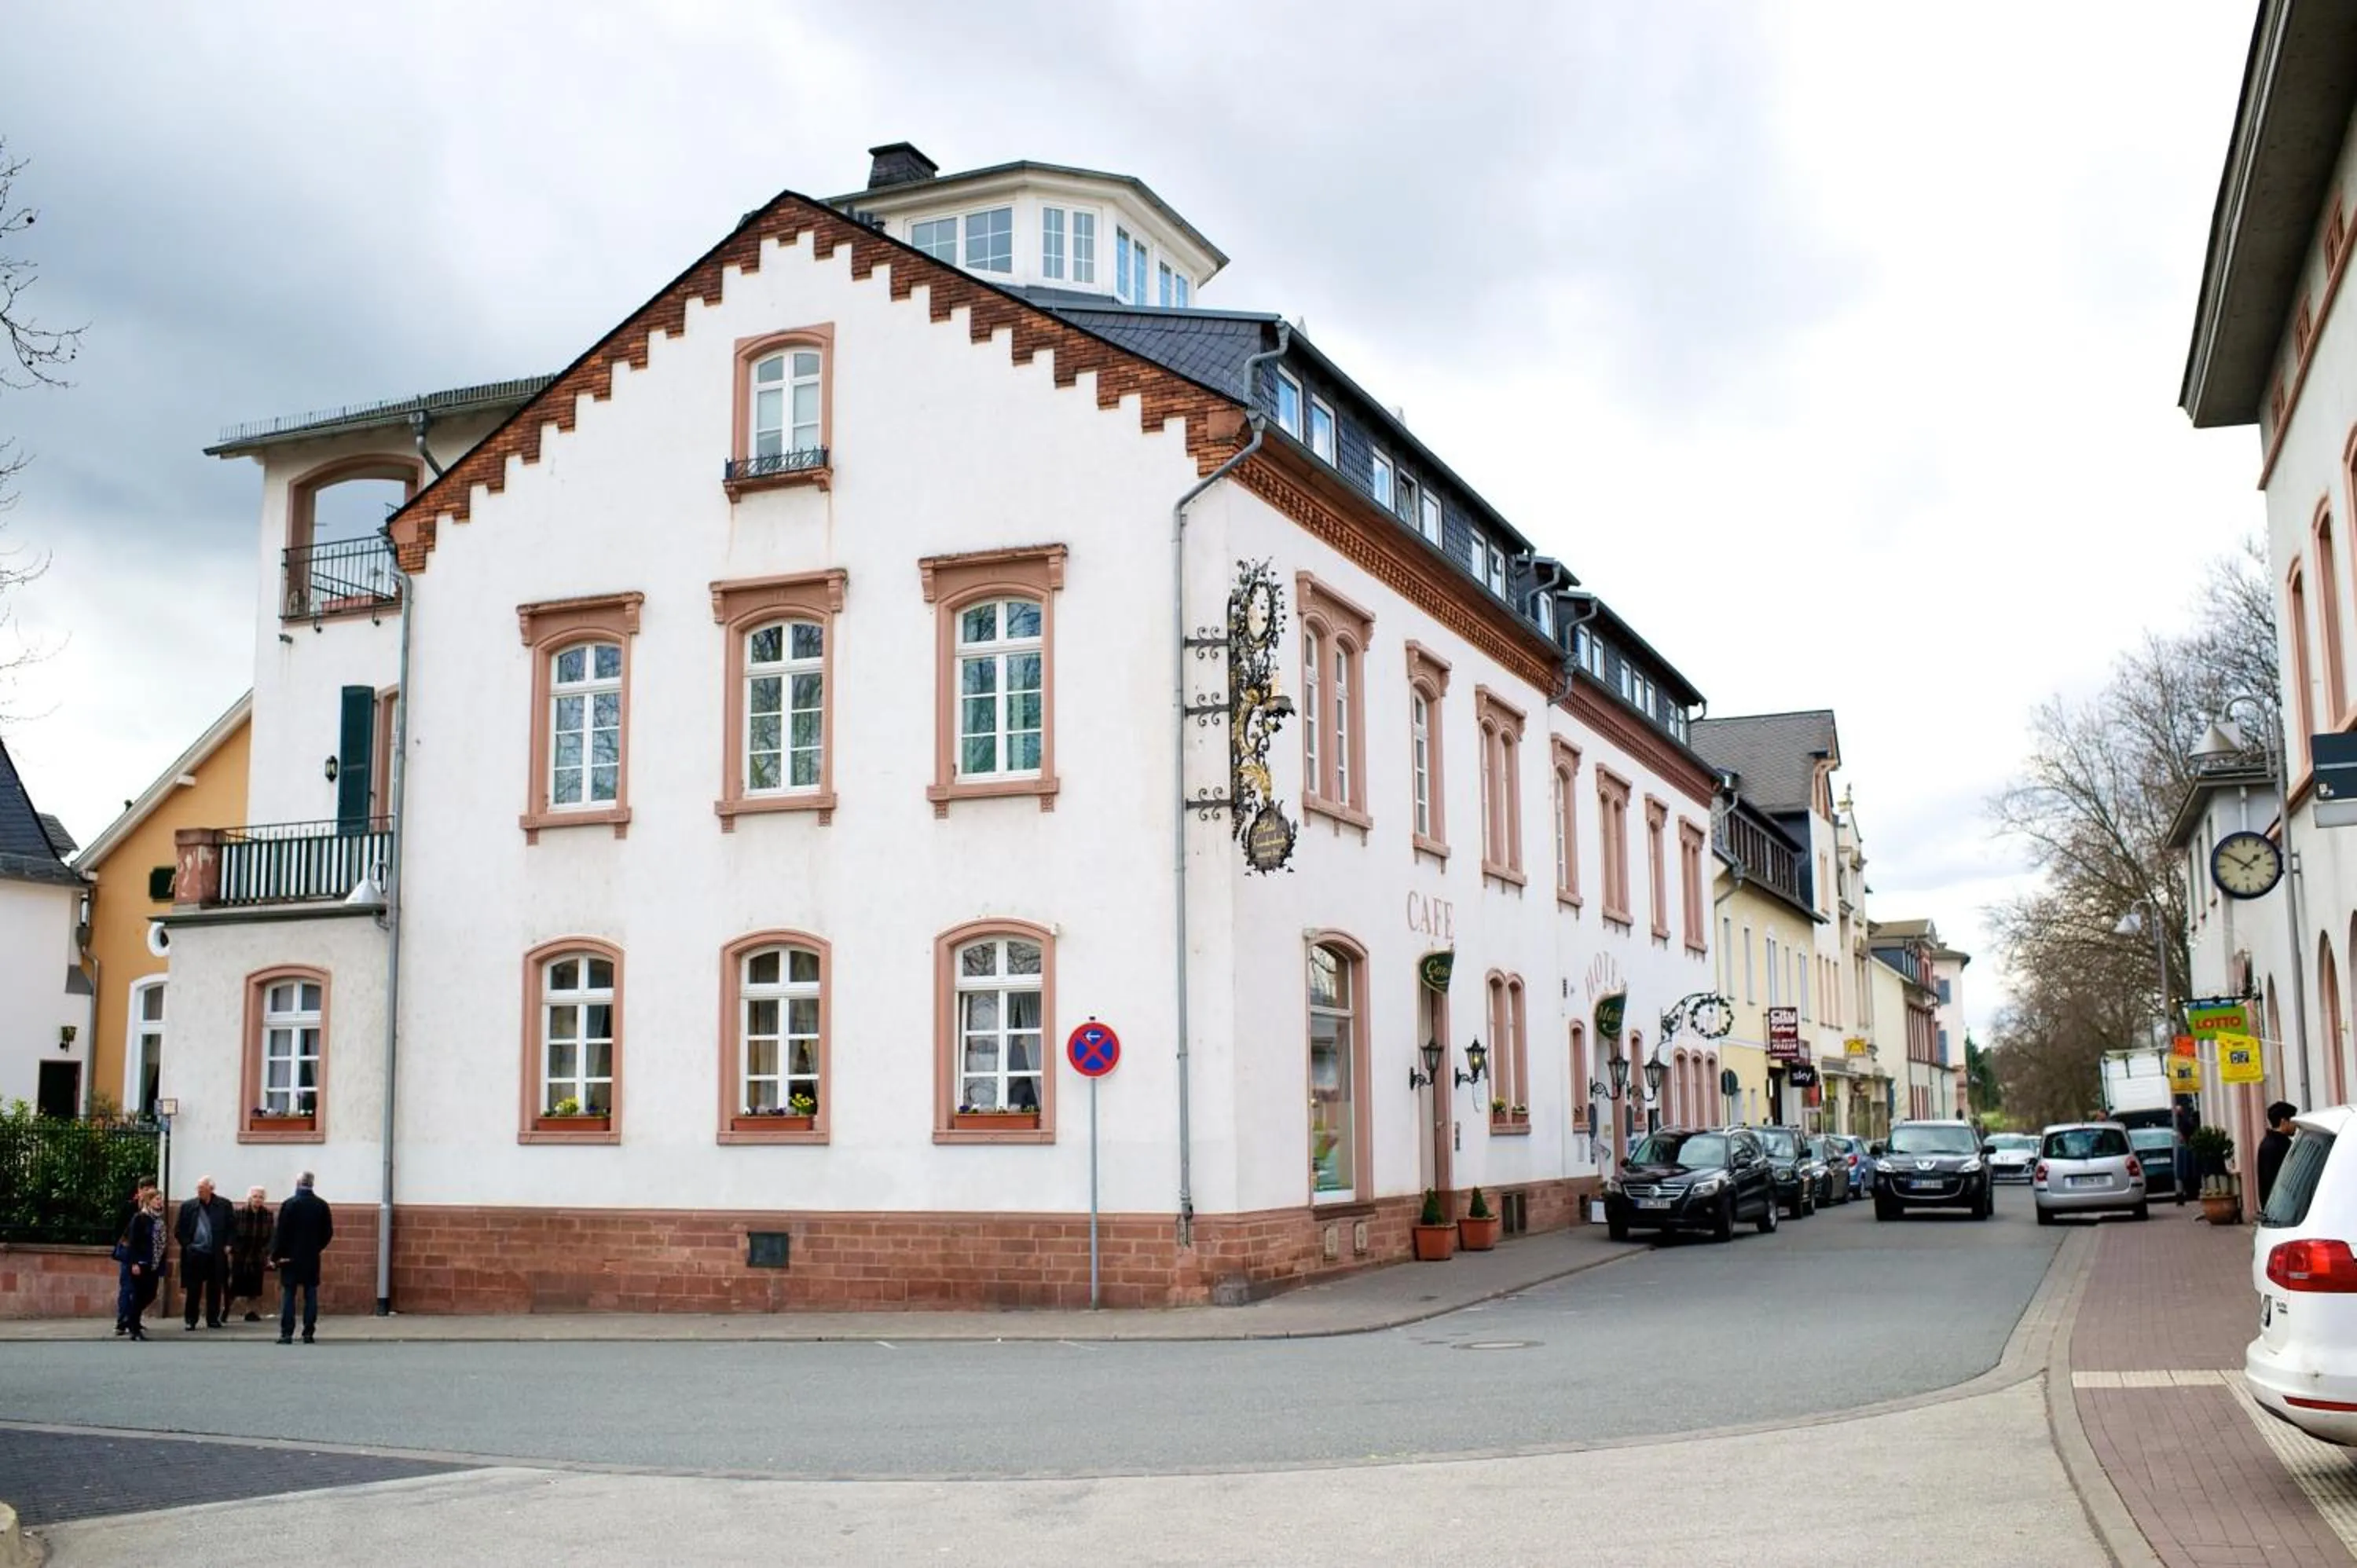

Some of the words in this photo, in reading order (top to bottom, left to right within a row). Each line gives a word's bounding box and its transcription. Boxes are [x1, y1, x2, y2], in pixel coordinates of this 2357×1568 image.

[1406, 890, 1453, 940] CAFE
[2195, 1016, 2242, 1031] LOTTO
[1793, 1070, 1812, 1082] sky
